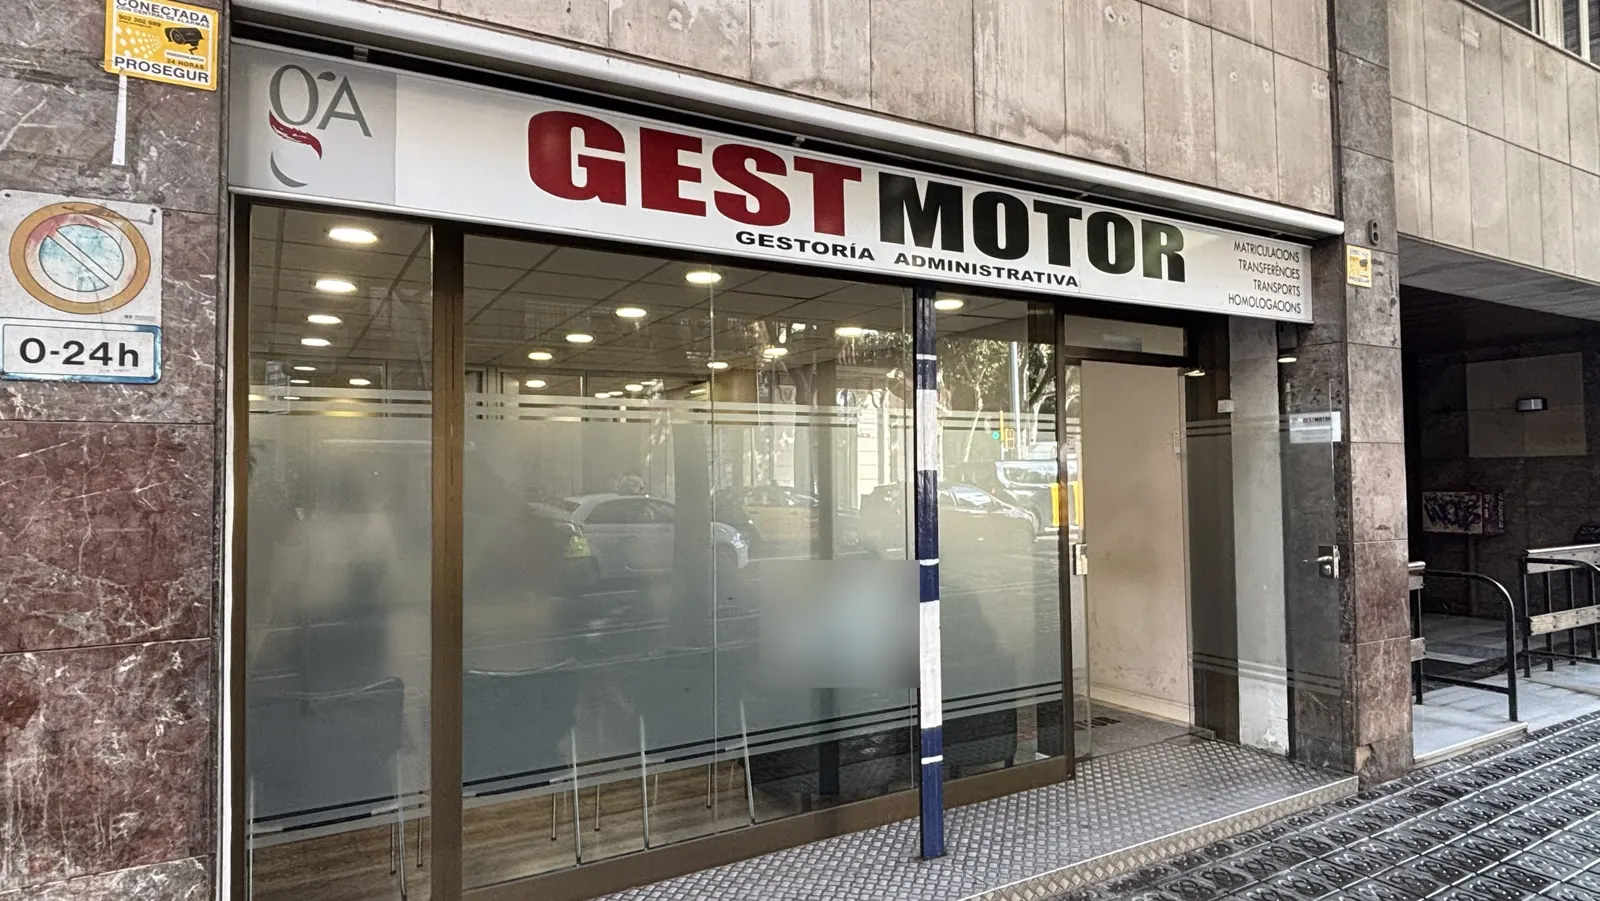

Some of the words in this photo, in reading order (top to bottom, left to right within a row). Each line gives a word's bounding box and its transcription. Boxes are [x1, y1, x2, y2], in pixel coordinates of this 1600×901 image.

[117, 0, 209, 24] CONECTADA
[133, 9, 163, 19] CENTRAL
[177, 17, 210, 29] ALARMAS
[114, 56, 209, 83] PROSEGUR
[178, 59, 205, 70] HORAS
[736, 230, 875, 261] GESTORÍA
[893, 251, 1079, 288] ADMINISTRATIVA
[1233, 240, 1300, 263] MATRICULACIONS
[1253, 279, 1301, 297] TRANSPORTS
[1228, 293, 1301, 314] HOMOLOGACIONS
[19, 337, 139, 367] 0-24h
